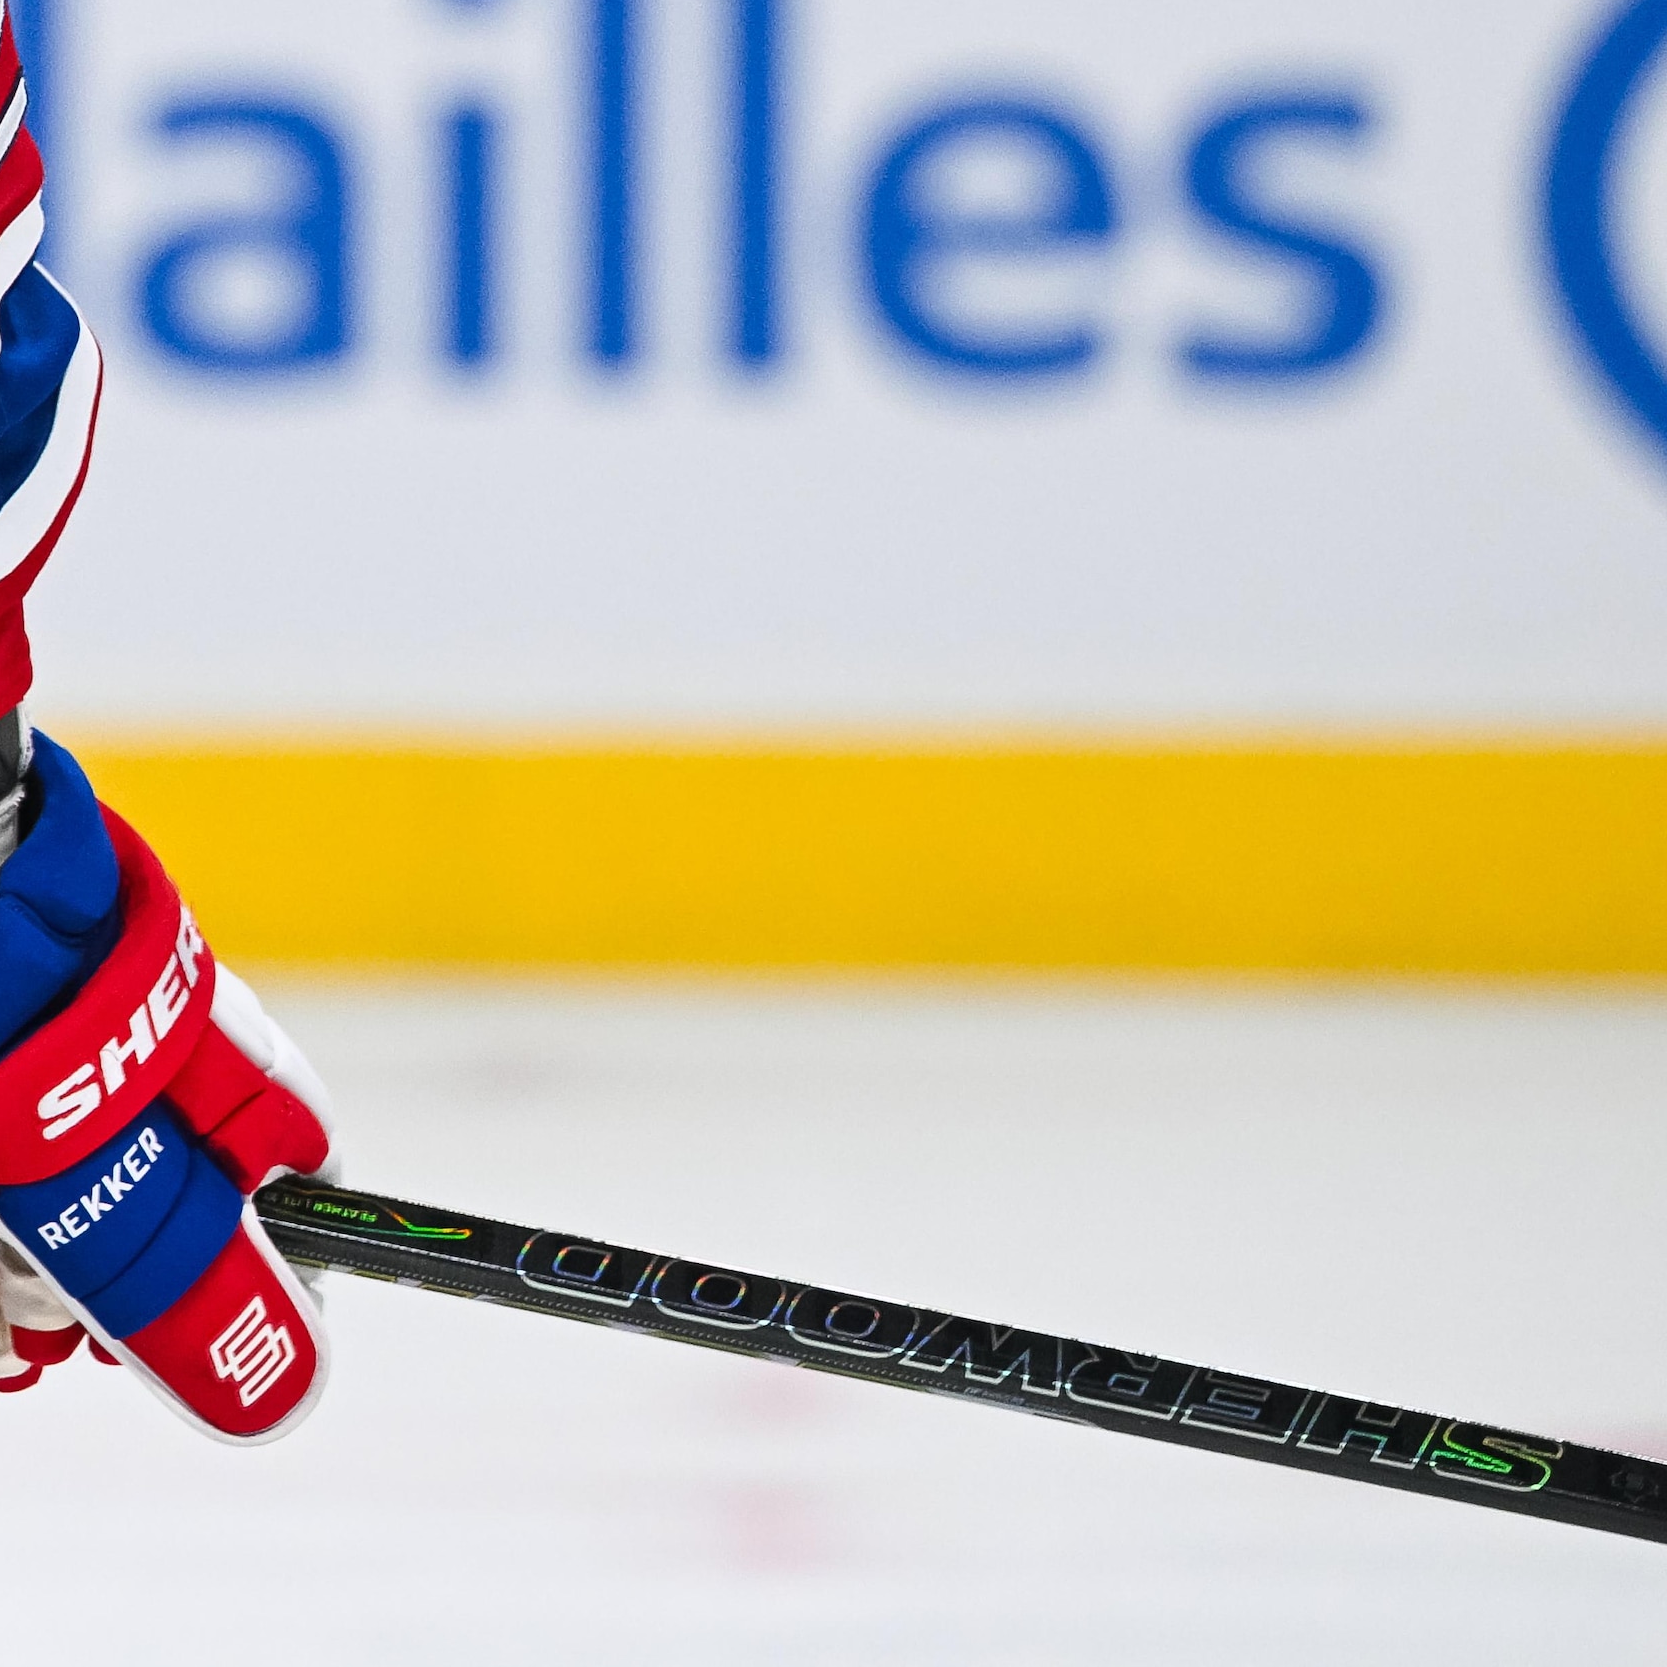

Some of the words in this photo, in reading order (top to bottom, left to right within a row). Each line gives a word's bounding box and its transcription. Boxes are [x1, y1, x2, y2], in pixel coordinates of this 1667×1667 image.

[37, 906, 203, 1140] SHER
[38, 1127, 166, 1250] REKKER
[516, 1230, 1564, 1492] SHERWOOD
